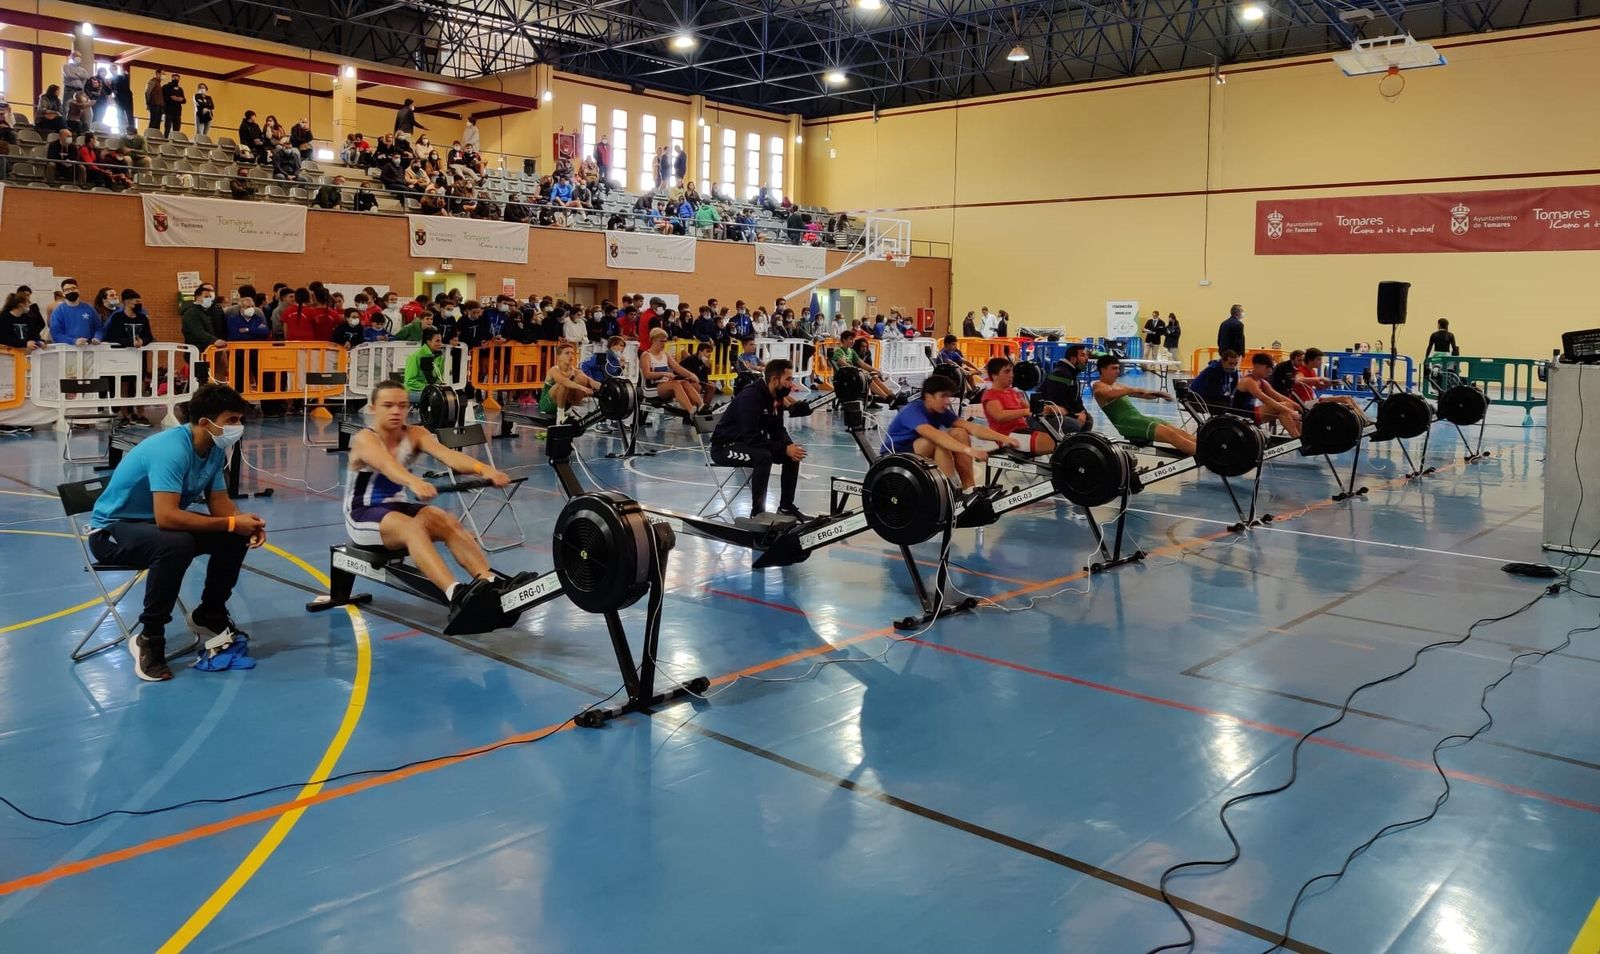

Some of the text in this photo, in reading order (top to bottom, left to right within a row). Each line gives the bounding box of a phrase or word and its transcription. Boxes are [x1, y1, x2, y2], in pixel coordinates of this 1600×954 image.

[1335, 215, 1383, 226] Tomares
[1532, 208, 1590, 220] Tomares
[1153, 465, 1177, 478] ERG-04
[1008, 491, 1033, 505] ERG-03
[816, 525, 844, 541] ERG-02
[518, 583, 546, 602] ERG-01
